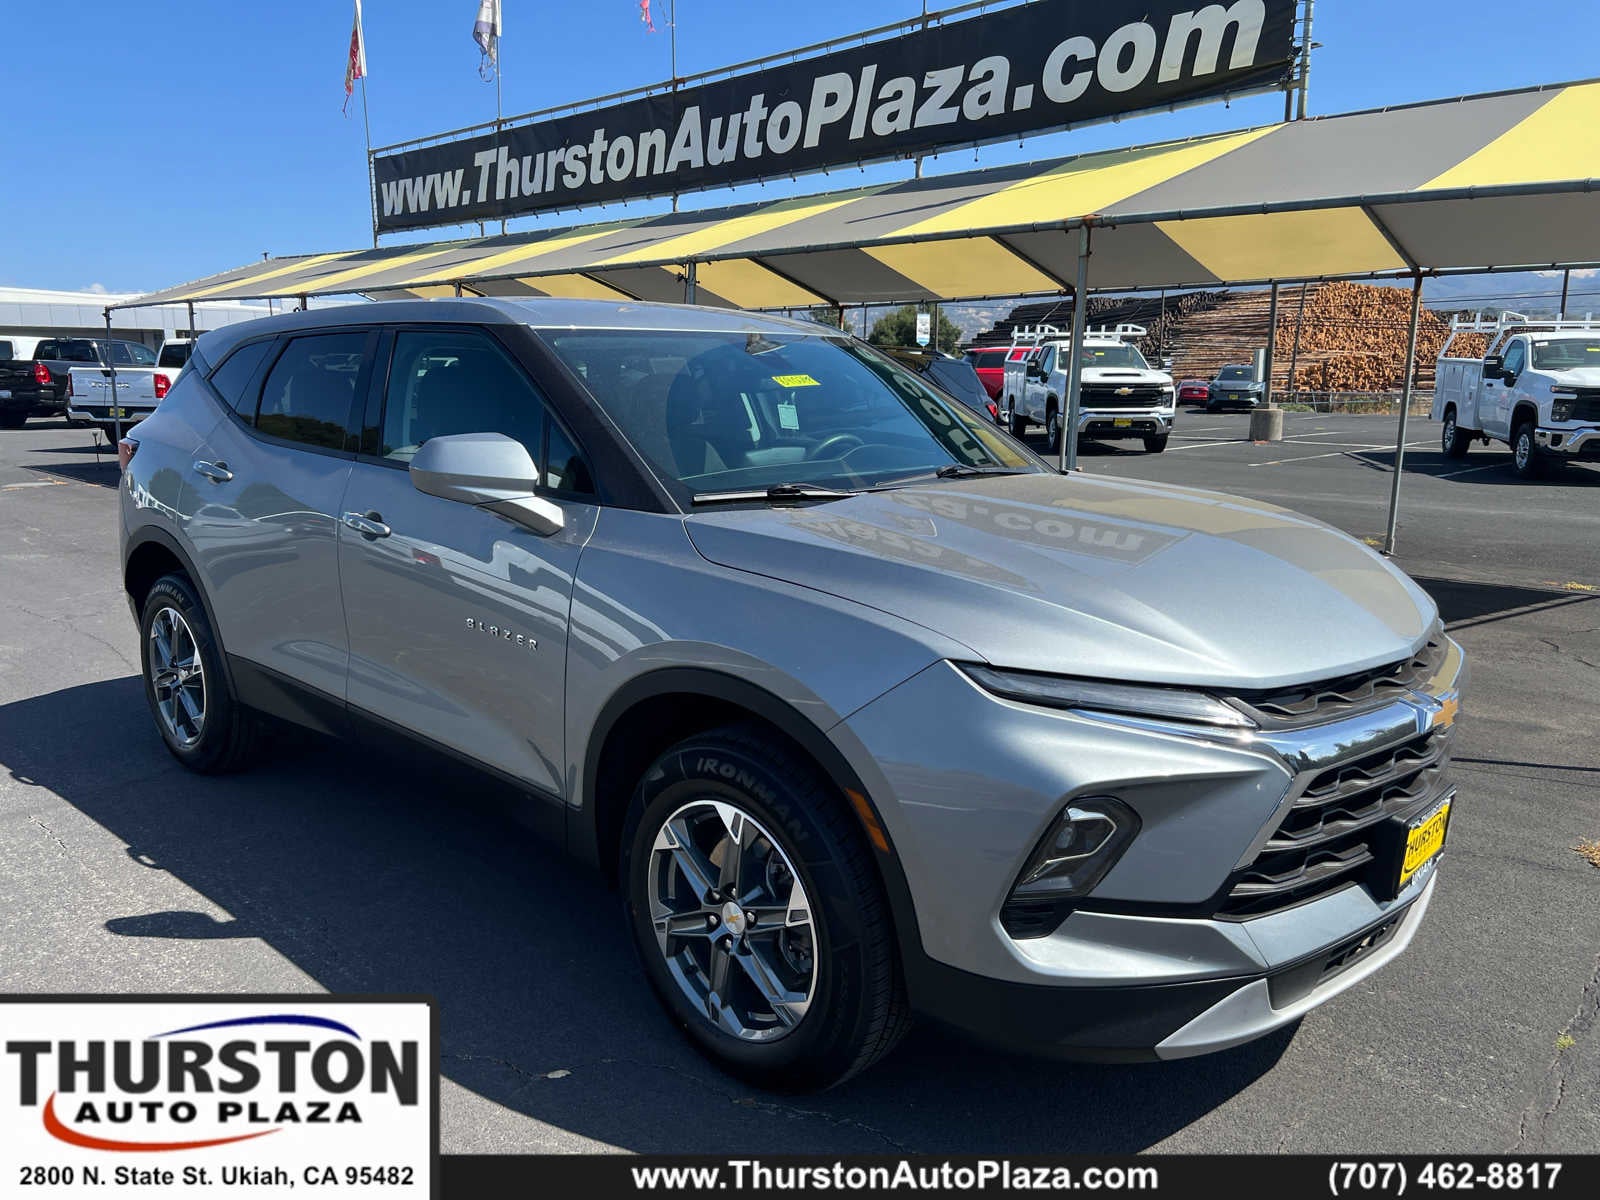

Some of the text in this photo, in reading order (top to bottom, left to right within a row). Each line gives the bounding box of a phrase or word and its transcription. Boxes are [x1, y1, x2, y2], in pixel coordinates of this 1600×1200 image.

[380, 0, 1265, 217] www.ThurstonAutoPlaza.com
[465, 617, 538, 651] BLAZER
[697, 757, 809, 841] IRONMAN
